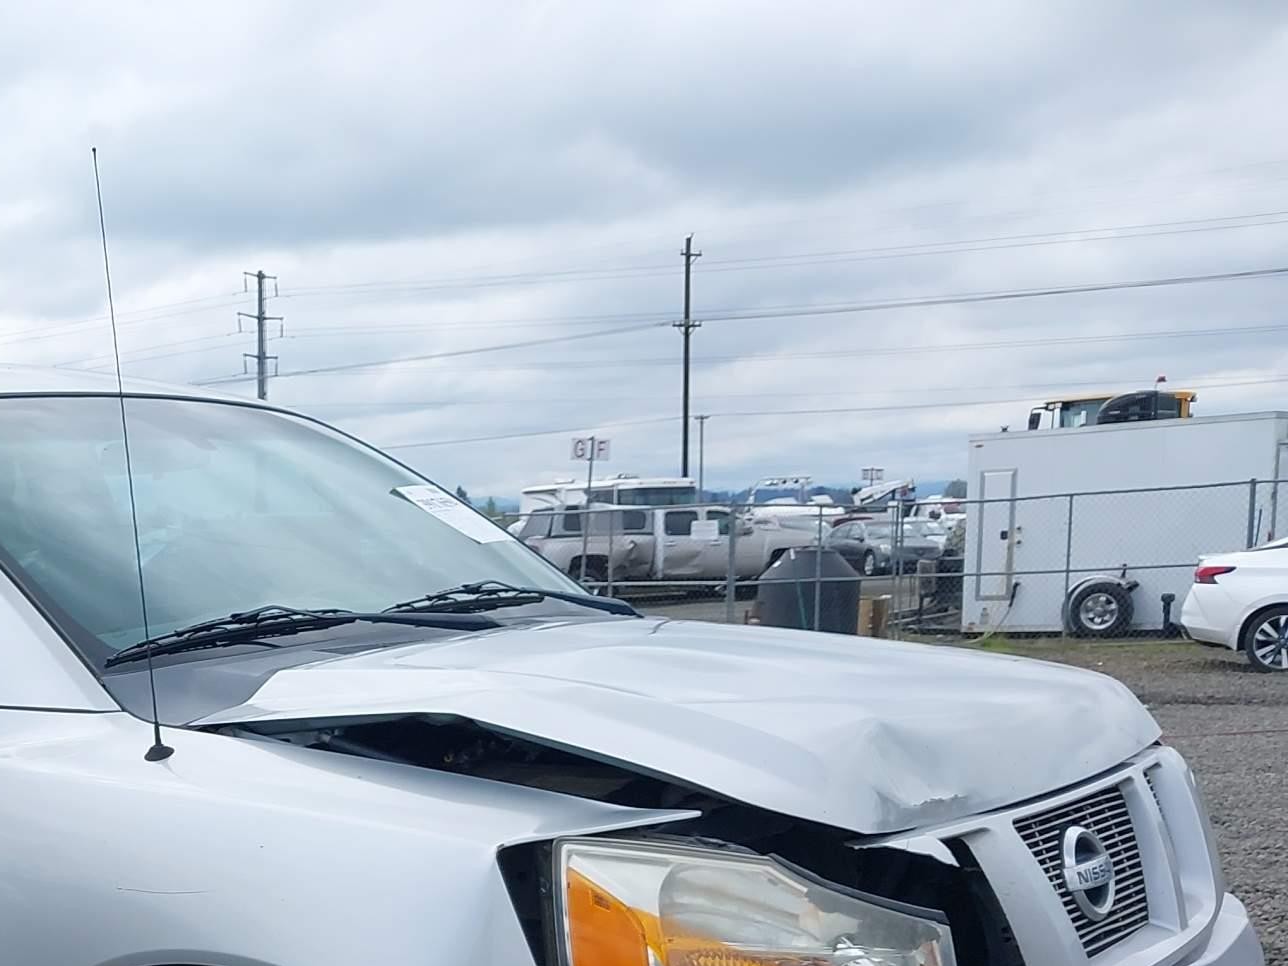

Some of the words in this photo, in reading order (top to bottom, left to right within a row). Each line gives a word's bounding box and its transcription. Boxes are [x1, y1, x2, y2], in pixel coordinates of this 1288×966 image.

[574, 440, 585, 458] G
[597, 440, 607, 459] F
[1076, 863, 1111, 885] NISS
